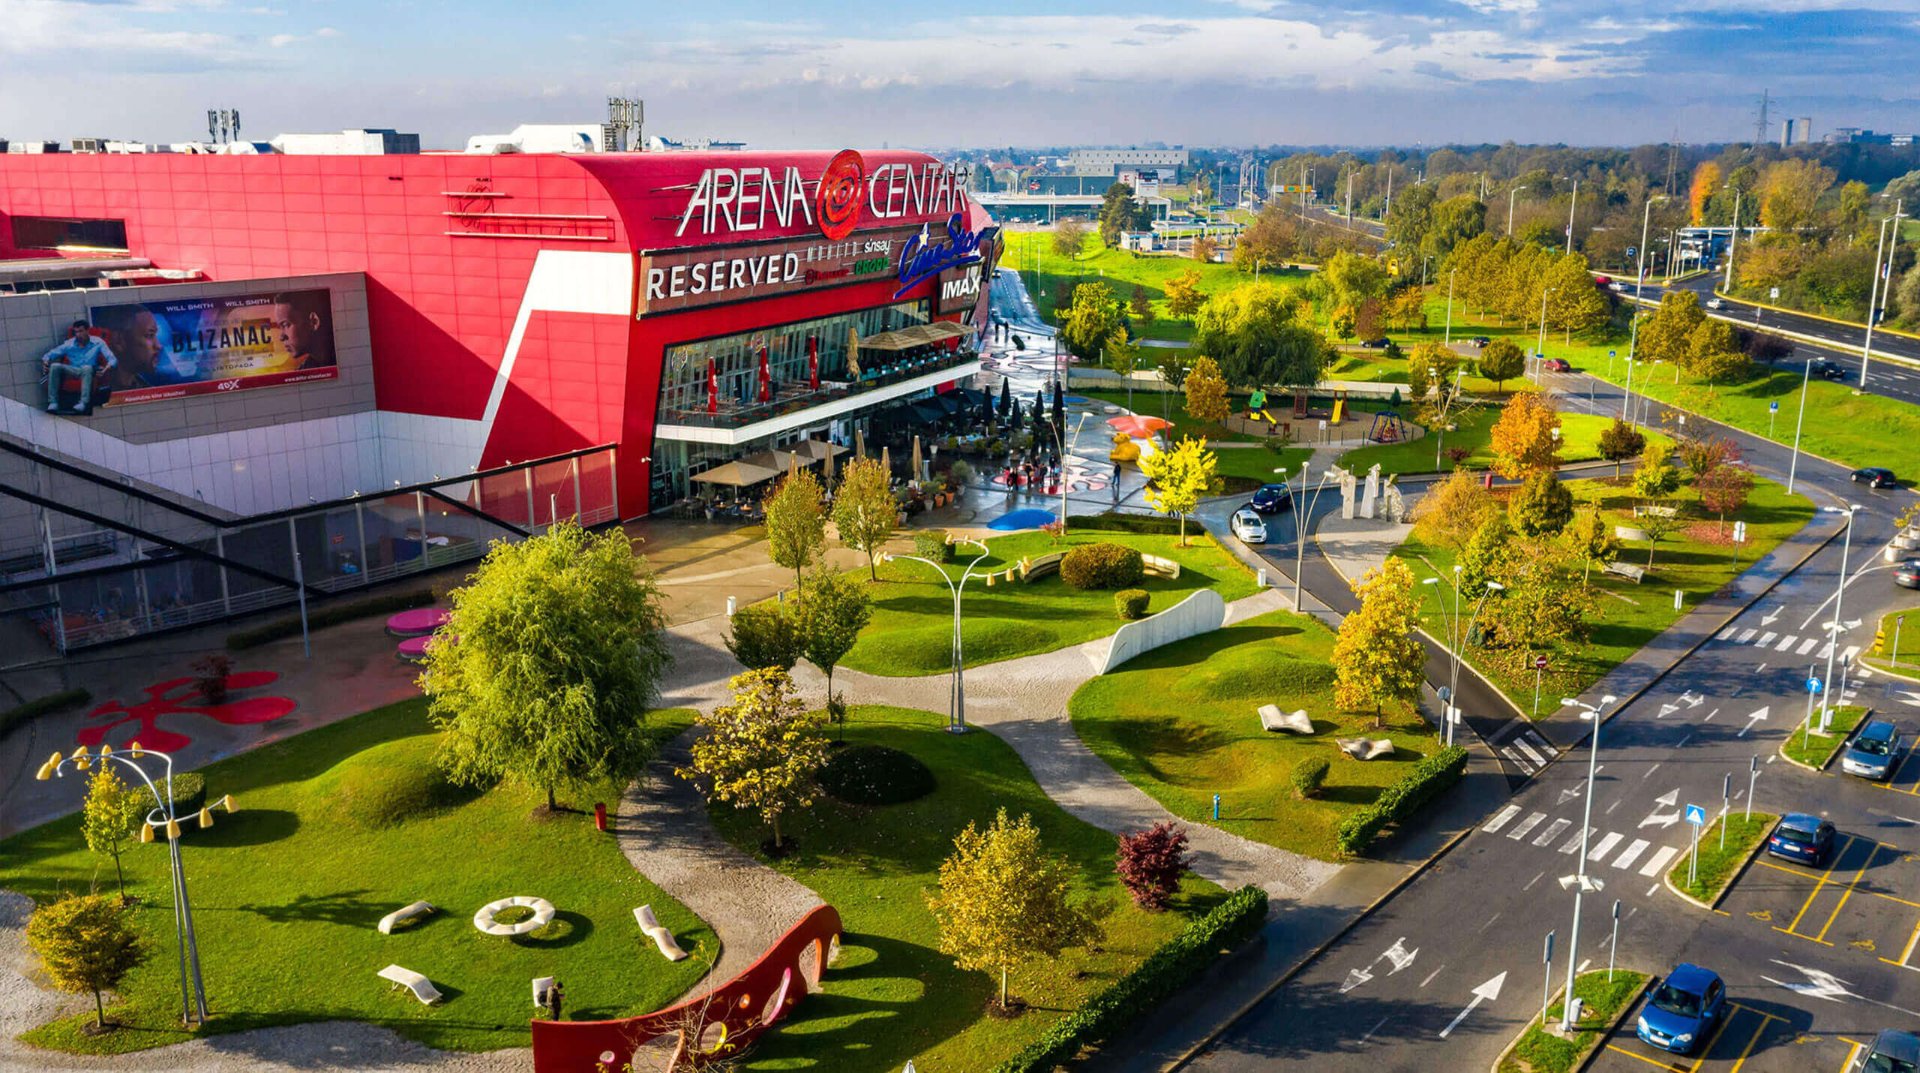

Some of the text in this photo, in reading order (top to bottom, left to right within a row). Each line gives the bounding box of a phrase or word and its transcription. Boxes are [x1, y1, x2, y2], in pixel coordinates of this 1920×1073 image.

[674, 163, 969, 237] ARENA CENTAR
[864, 238, 891, 256] sinsay
[646, 252, 799, 300] RESERVED
[942, 275, 980, 300] IMAX
[188, 302, 214, 310] SMITH
[246, 298, 270, 306] SMITH
[172, 324, 273, 353] BLIZANAC
